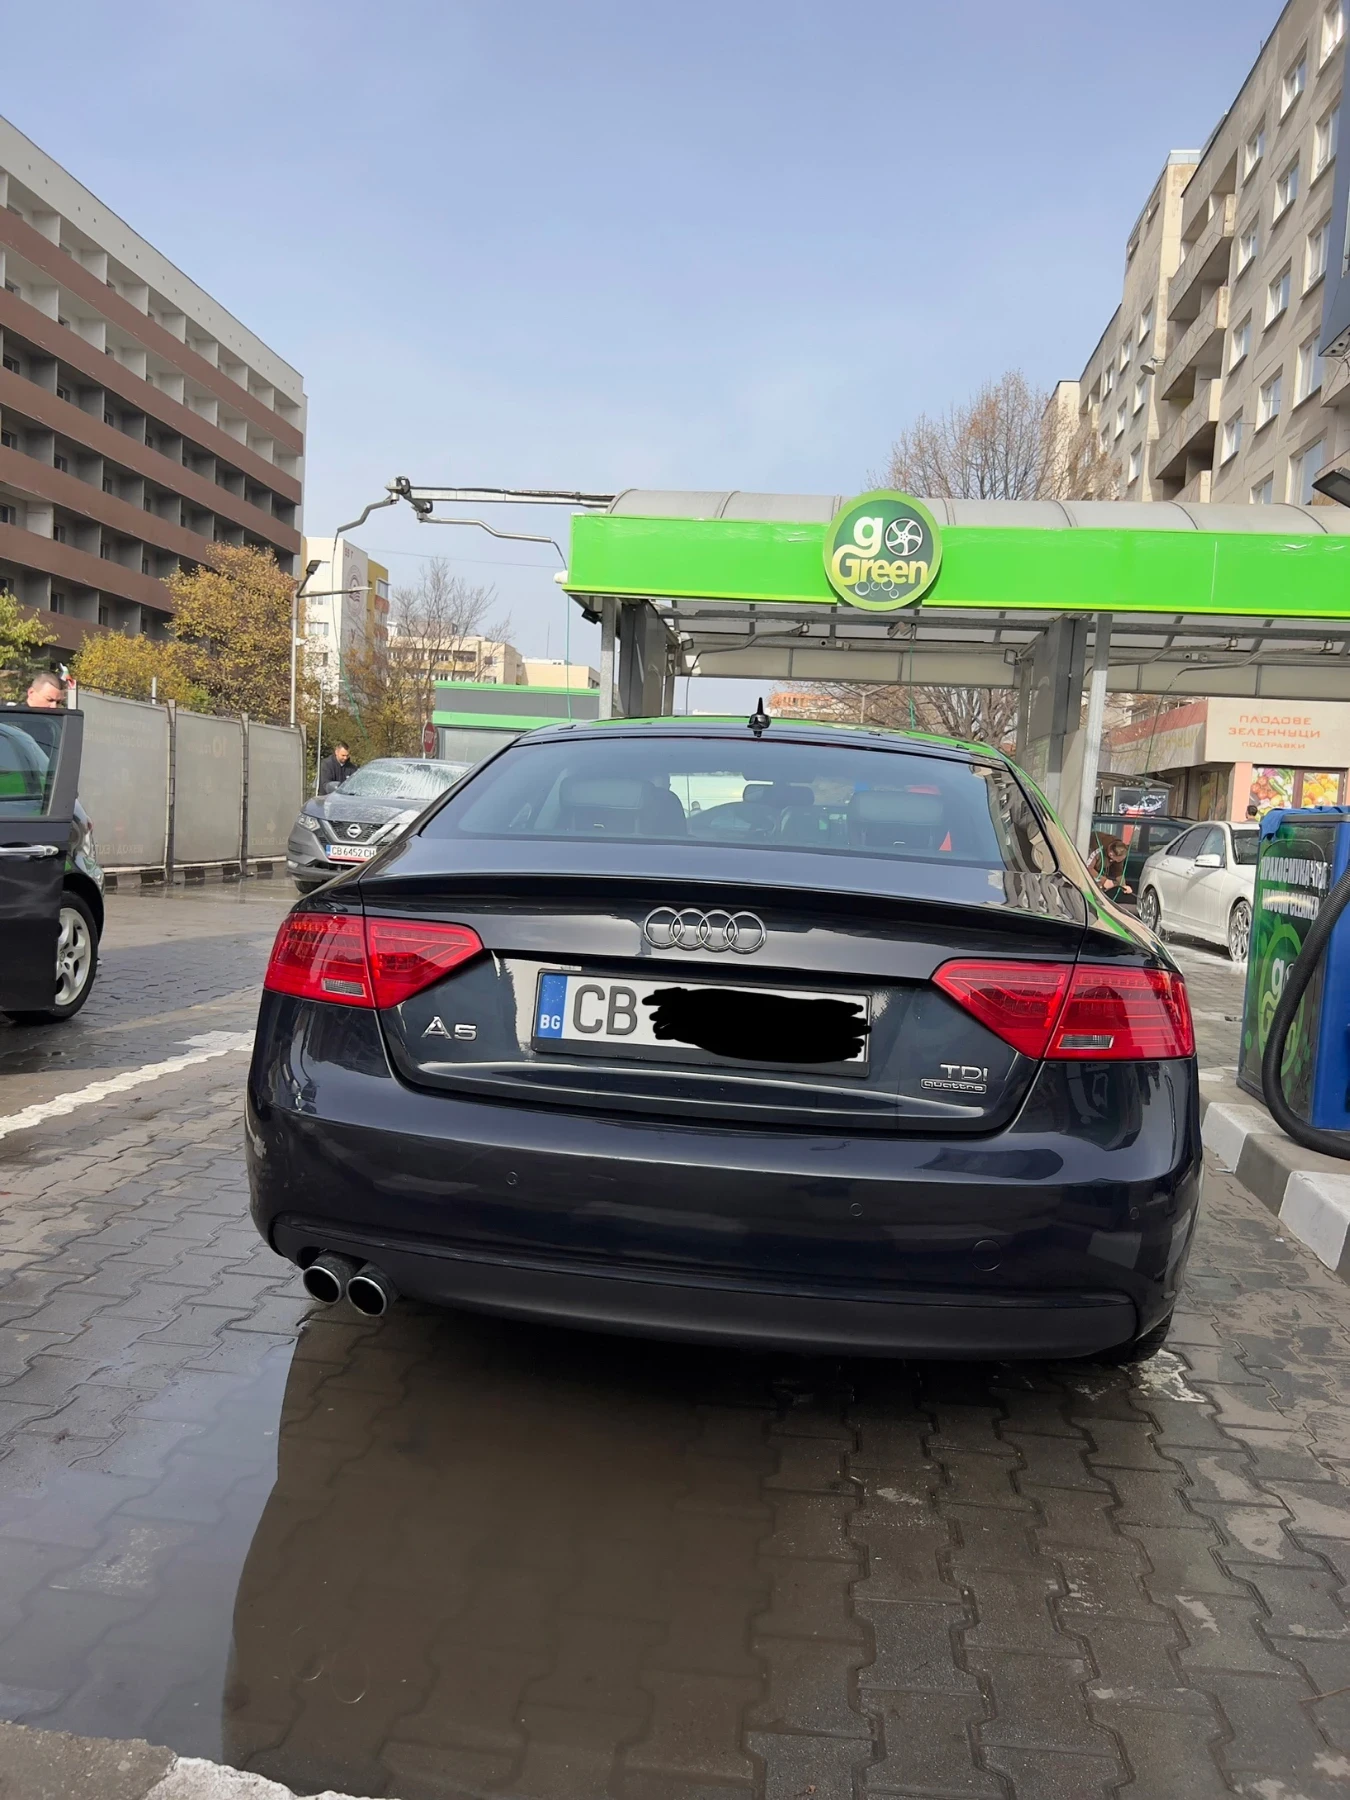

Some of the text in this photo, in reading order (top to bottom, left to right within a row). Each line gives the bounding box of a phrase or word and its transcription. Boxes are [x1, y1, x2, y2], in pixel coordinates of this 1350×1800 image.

[832, 544, 928, 586] Green
[1239, 715, 1312, 725] ПЛОДОВЕ
[1228, 727, 1321, 739] ЗЕЛЕНЧУЦИ
[1241, 741, 1306, 749] ПОДПРАВКИ
[343, 847, 363, 857] 6452
[572, 984, 638, 1035] CB
[420, 1015, 478, 1041] A5
[540, 1013, 561, 1031] BG
[940, 1063, 989, 1082] TDI
[924, 1080, 984, 1091] quattro
